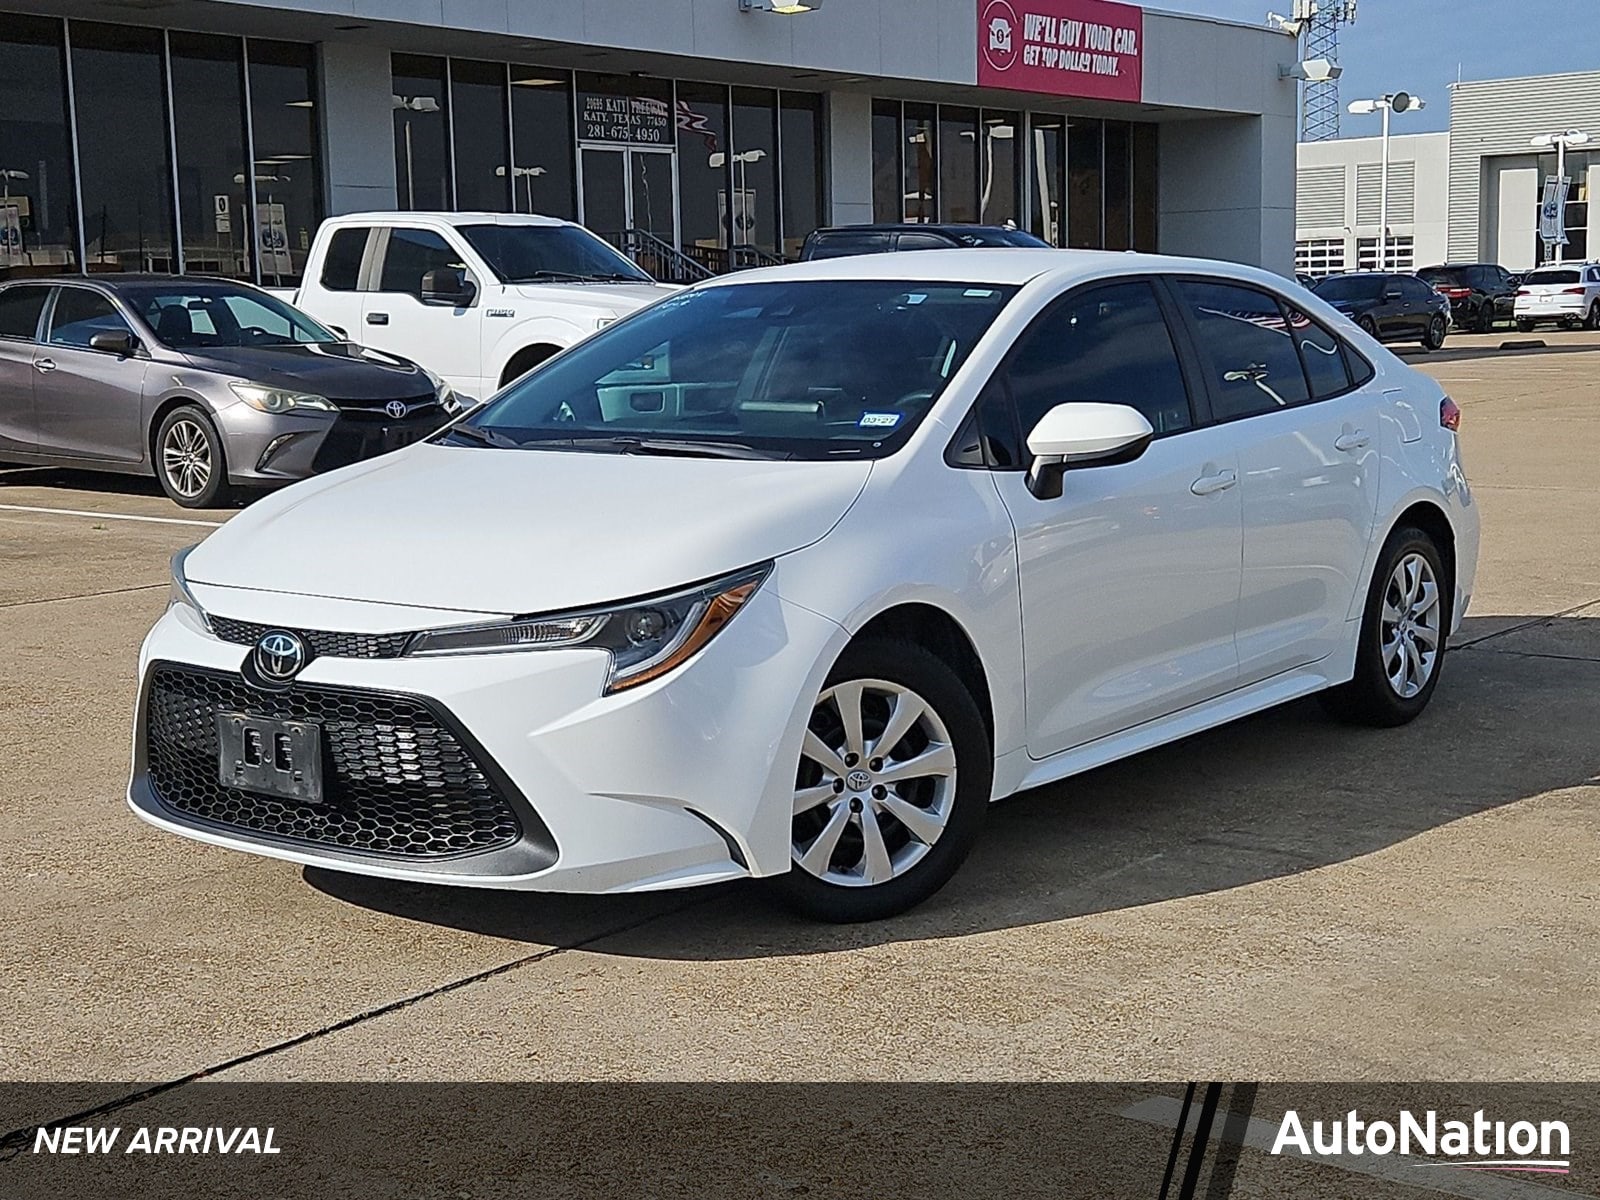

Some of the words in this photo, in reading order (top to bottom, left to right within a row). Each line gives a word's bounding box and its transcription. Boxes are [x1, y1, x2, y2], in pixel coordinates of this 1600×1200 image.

[1024, 13, 1057, 44] WE'LL
[1059, 19, 1084, 48] BUY
[1084, 23, 1113, 51] YOUR
[1114, 28, 1137, 56] CAR.
[1023, 44, 1040, 66] GET
[1041, 47, 1058, 69] TOP
[1059, 50, 1091, 73] DOLLAR
[1092, 54, 1119, 77] TODAY.
[605, 98, 627, 113] KATY
[612, 113, 641, 125] TEXAS
